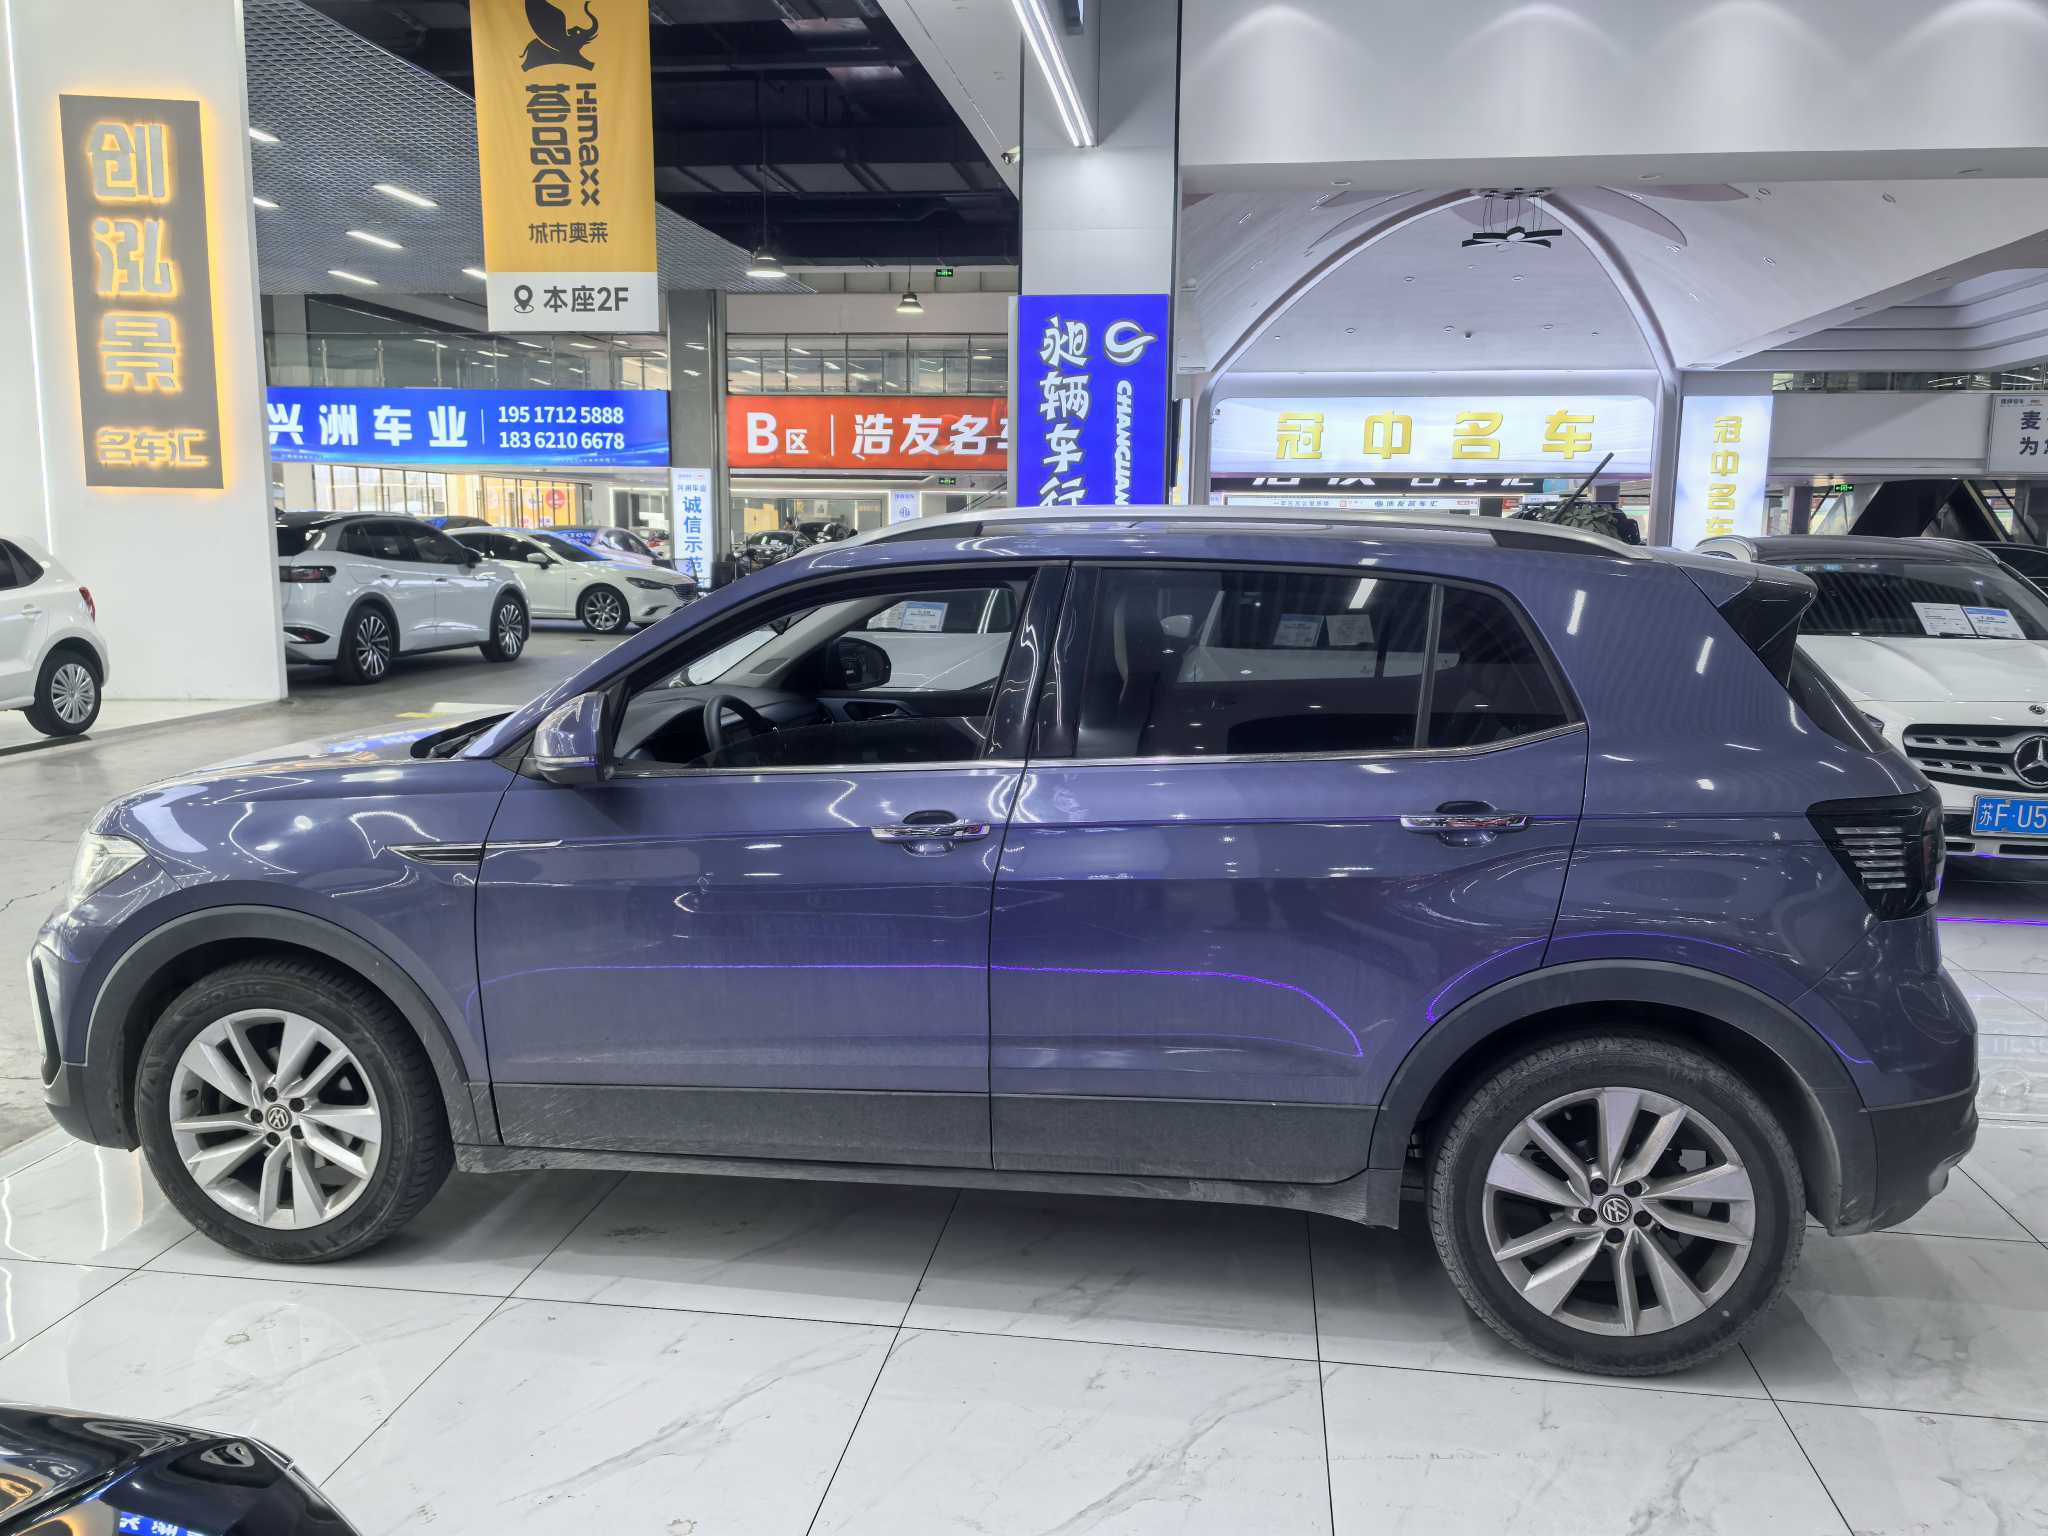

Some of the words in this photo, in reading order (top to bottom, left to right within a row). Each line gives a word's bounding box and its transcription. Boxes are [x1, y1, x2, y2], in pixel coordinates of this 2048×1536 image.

[528, 222, 608, 244] 城市奥莱
[89, 122, 176, 388] 创泓景
[543, 285, 629, 313] 本座2F
[266, 403, 468, 448] 兴洲车业
[498, 406, 530, 423] 195
[534, 406, 577, 424] 1712
[580, 407, 624, 425] 5888
[2020, 410, 2048, 430] 麦
[98, 430, 207, 464] 名车汇
[500, 432, 532, 448] 183
[534, 432, 578, 449] 6210
[581, 432, 625, 449] 6678
[746, 412, 809, 455] B区
[852, 413, 1008, 460] 浩友名
[1276, 410, 1595, 459] 冠中名车
[2019, 436, 2048, 455] 为
[1706, 415, 1742, 536] 冠中名车
[683, 496, 705, 589] 诚信示范
